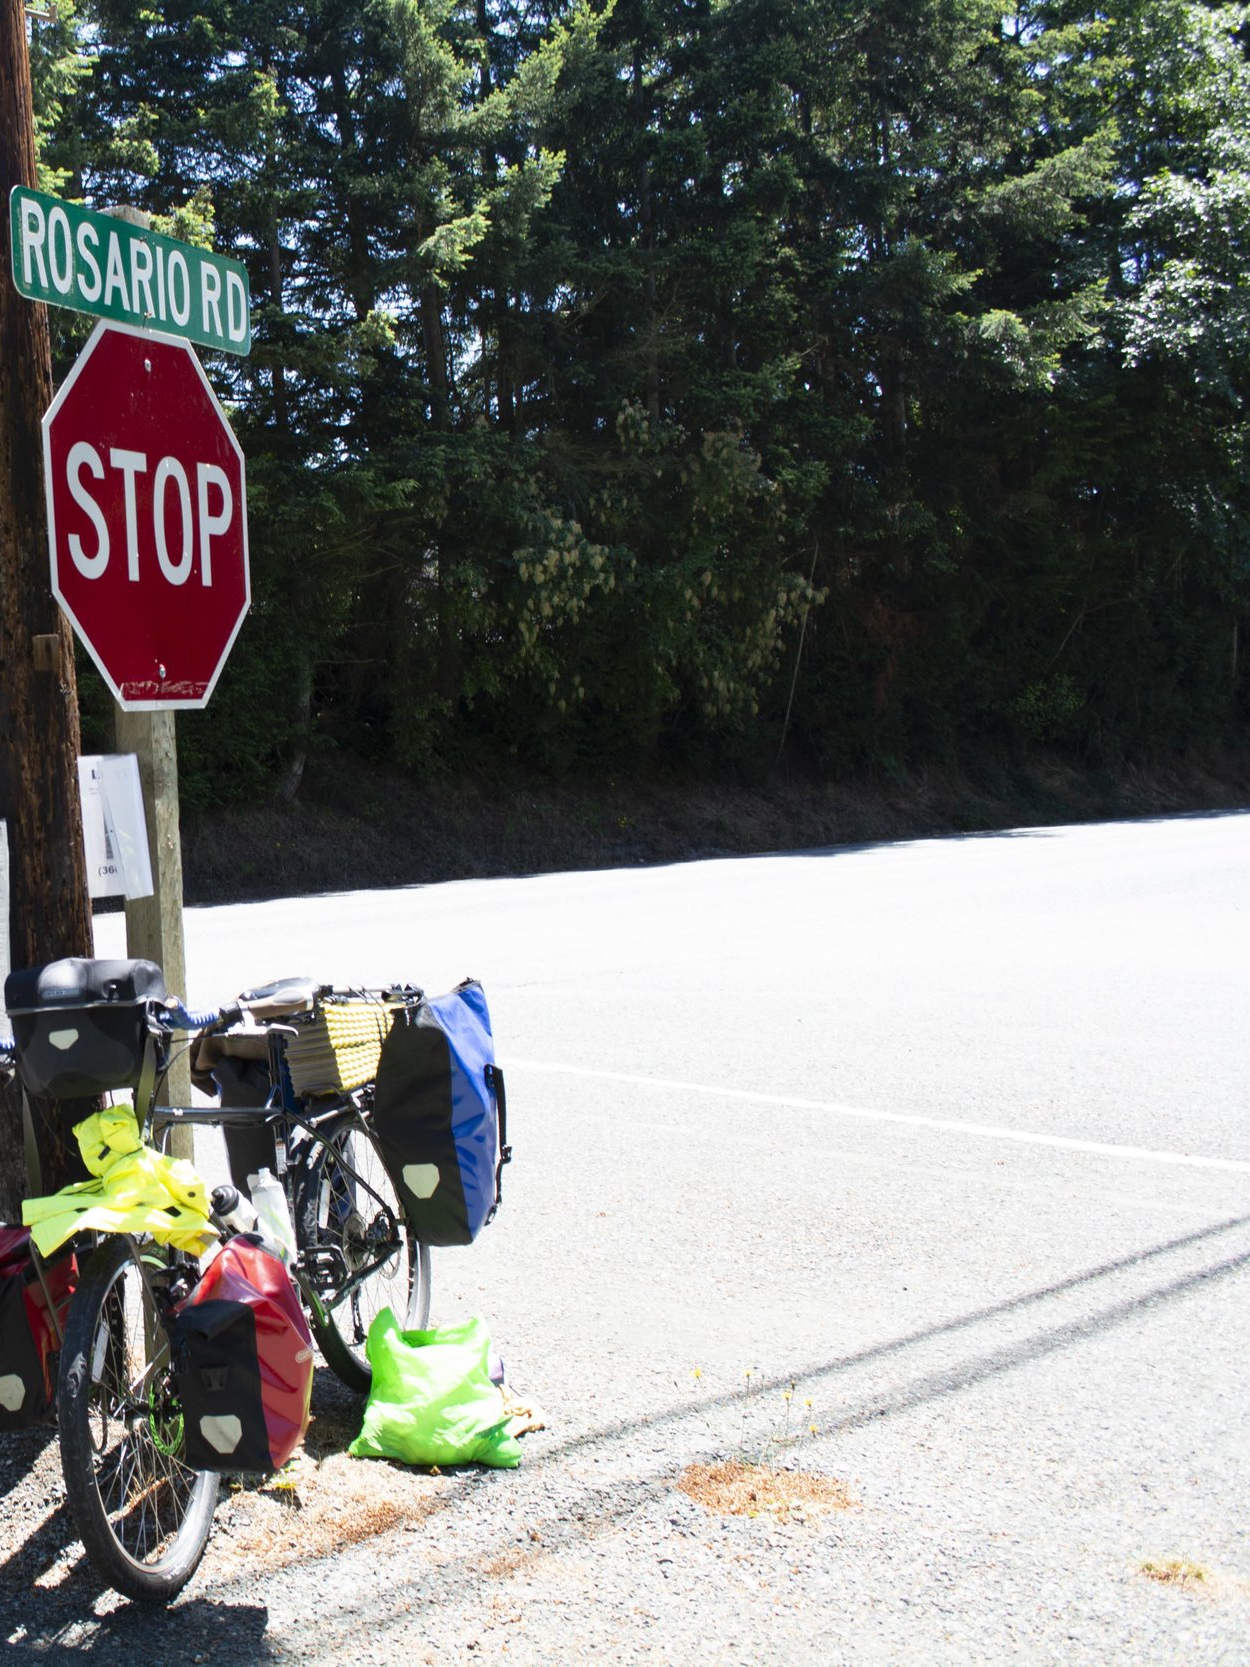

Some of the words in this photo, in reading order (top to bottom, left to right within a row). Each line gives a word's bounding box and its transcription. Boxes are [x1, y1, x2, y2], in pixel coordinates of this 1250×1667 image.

[20, 197, 191, 327] ROSARIO
[200, 260, 247, 343] RD
[66, 441, 233, 587] STOP
